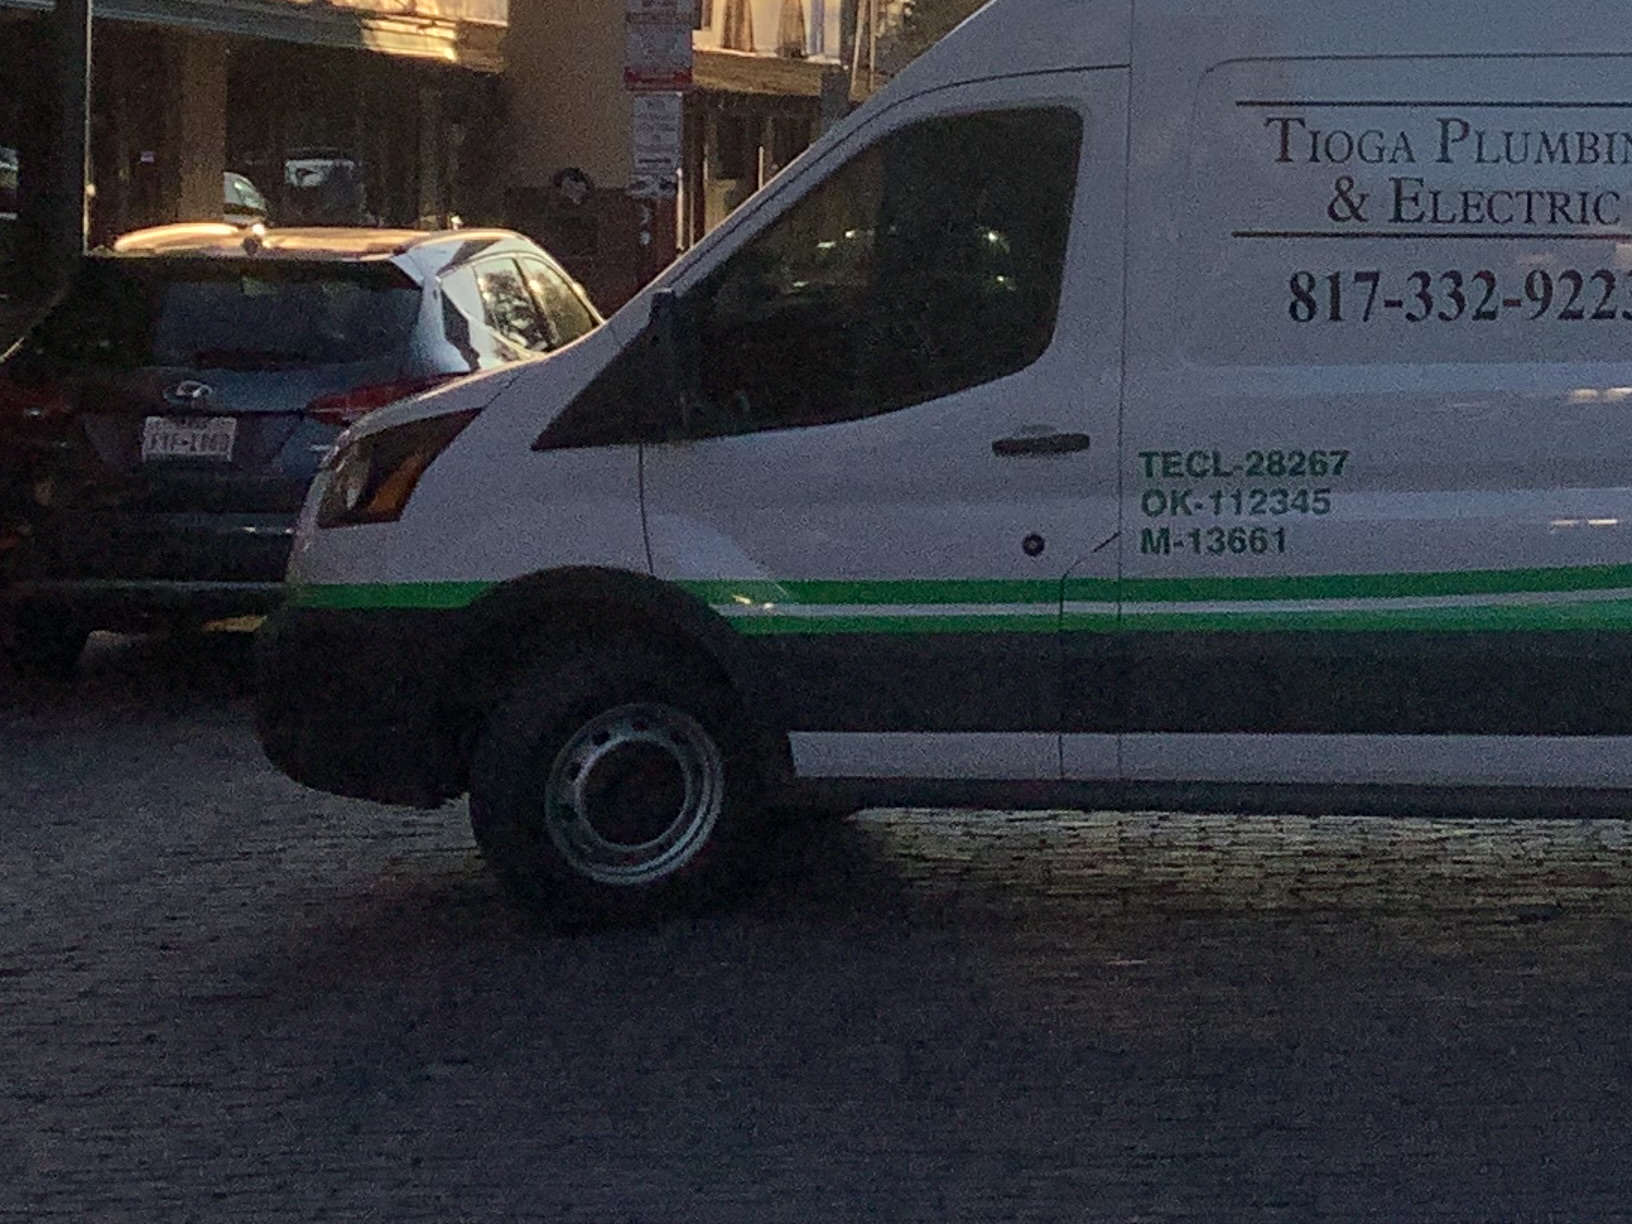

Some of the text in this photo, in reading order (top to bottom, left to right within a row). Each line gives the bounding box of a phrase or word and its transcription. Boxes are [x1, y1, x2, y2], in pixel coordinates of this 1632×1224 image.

[1327, 175, 1370, 223] &
[1138, 449, 1349, 478] TECL-28267
[1141, 488, 1332, 517] OK-112345
[1141, 527, 1286, 555] M-13661
